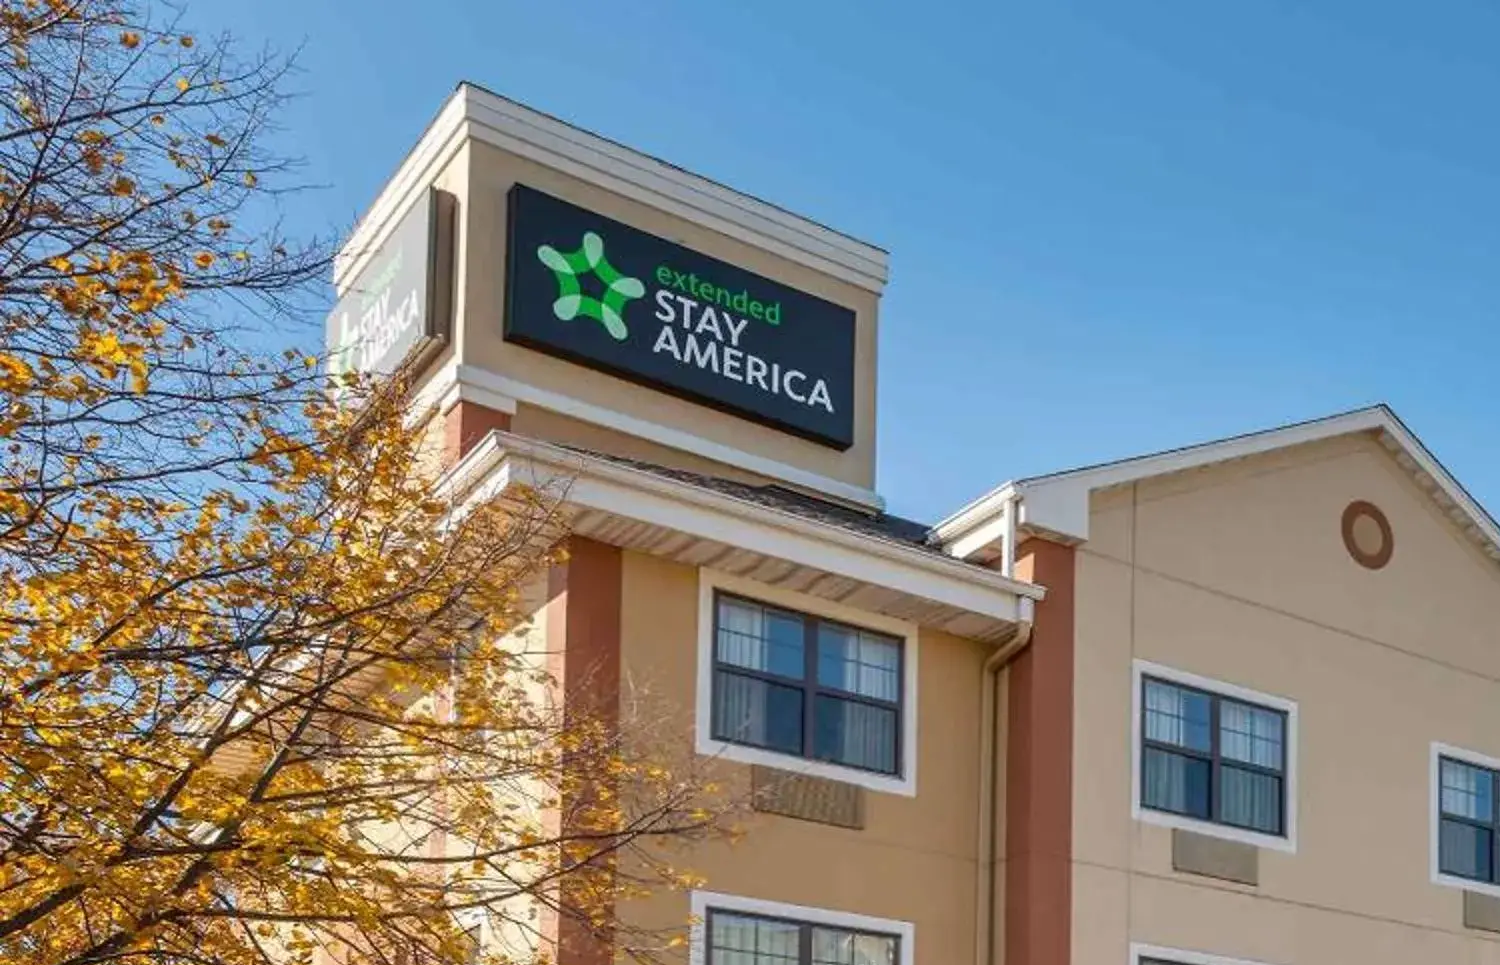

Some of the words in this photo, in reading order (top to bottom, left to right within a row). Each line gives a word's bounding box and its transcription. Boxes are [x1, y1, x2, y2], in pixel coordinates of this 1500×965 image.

[655, 265, 780, 326] extended
[655, 289, 749, 347] STAY
[652, 325, 835, 414] AMERICA
